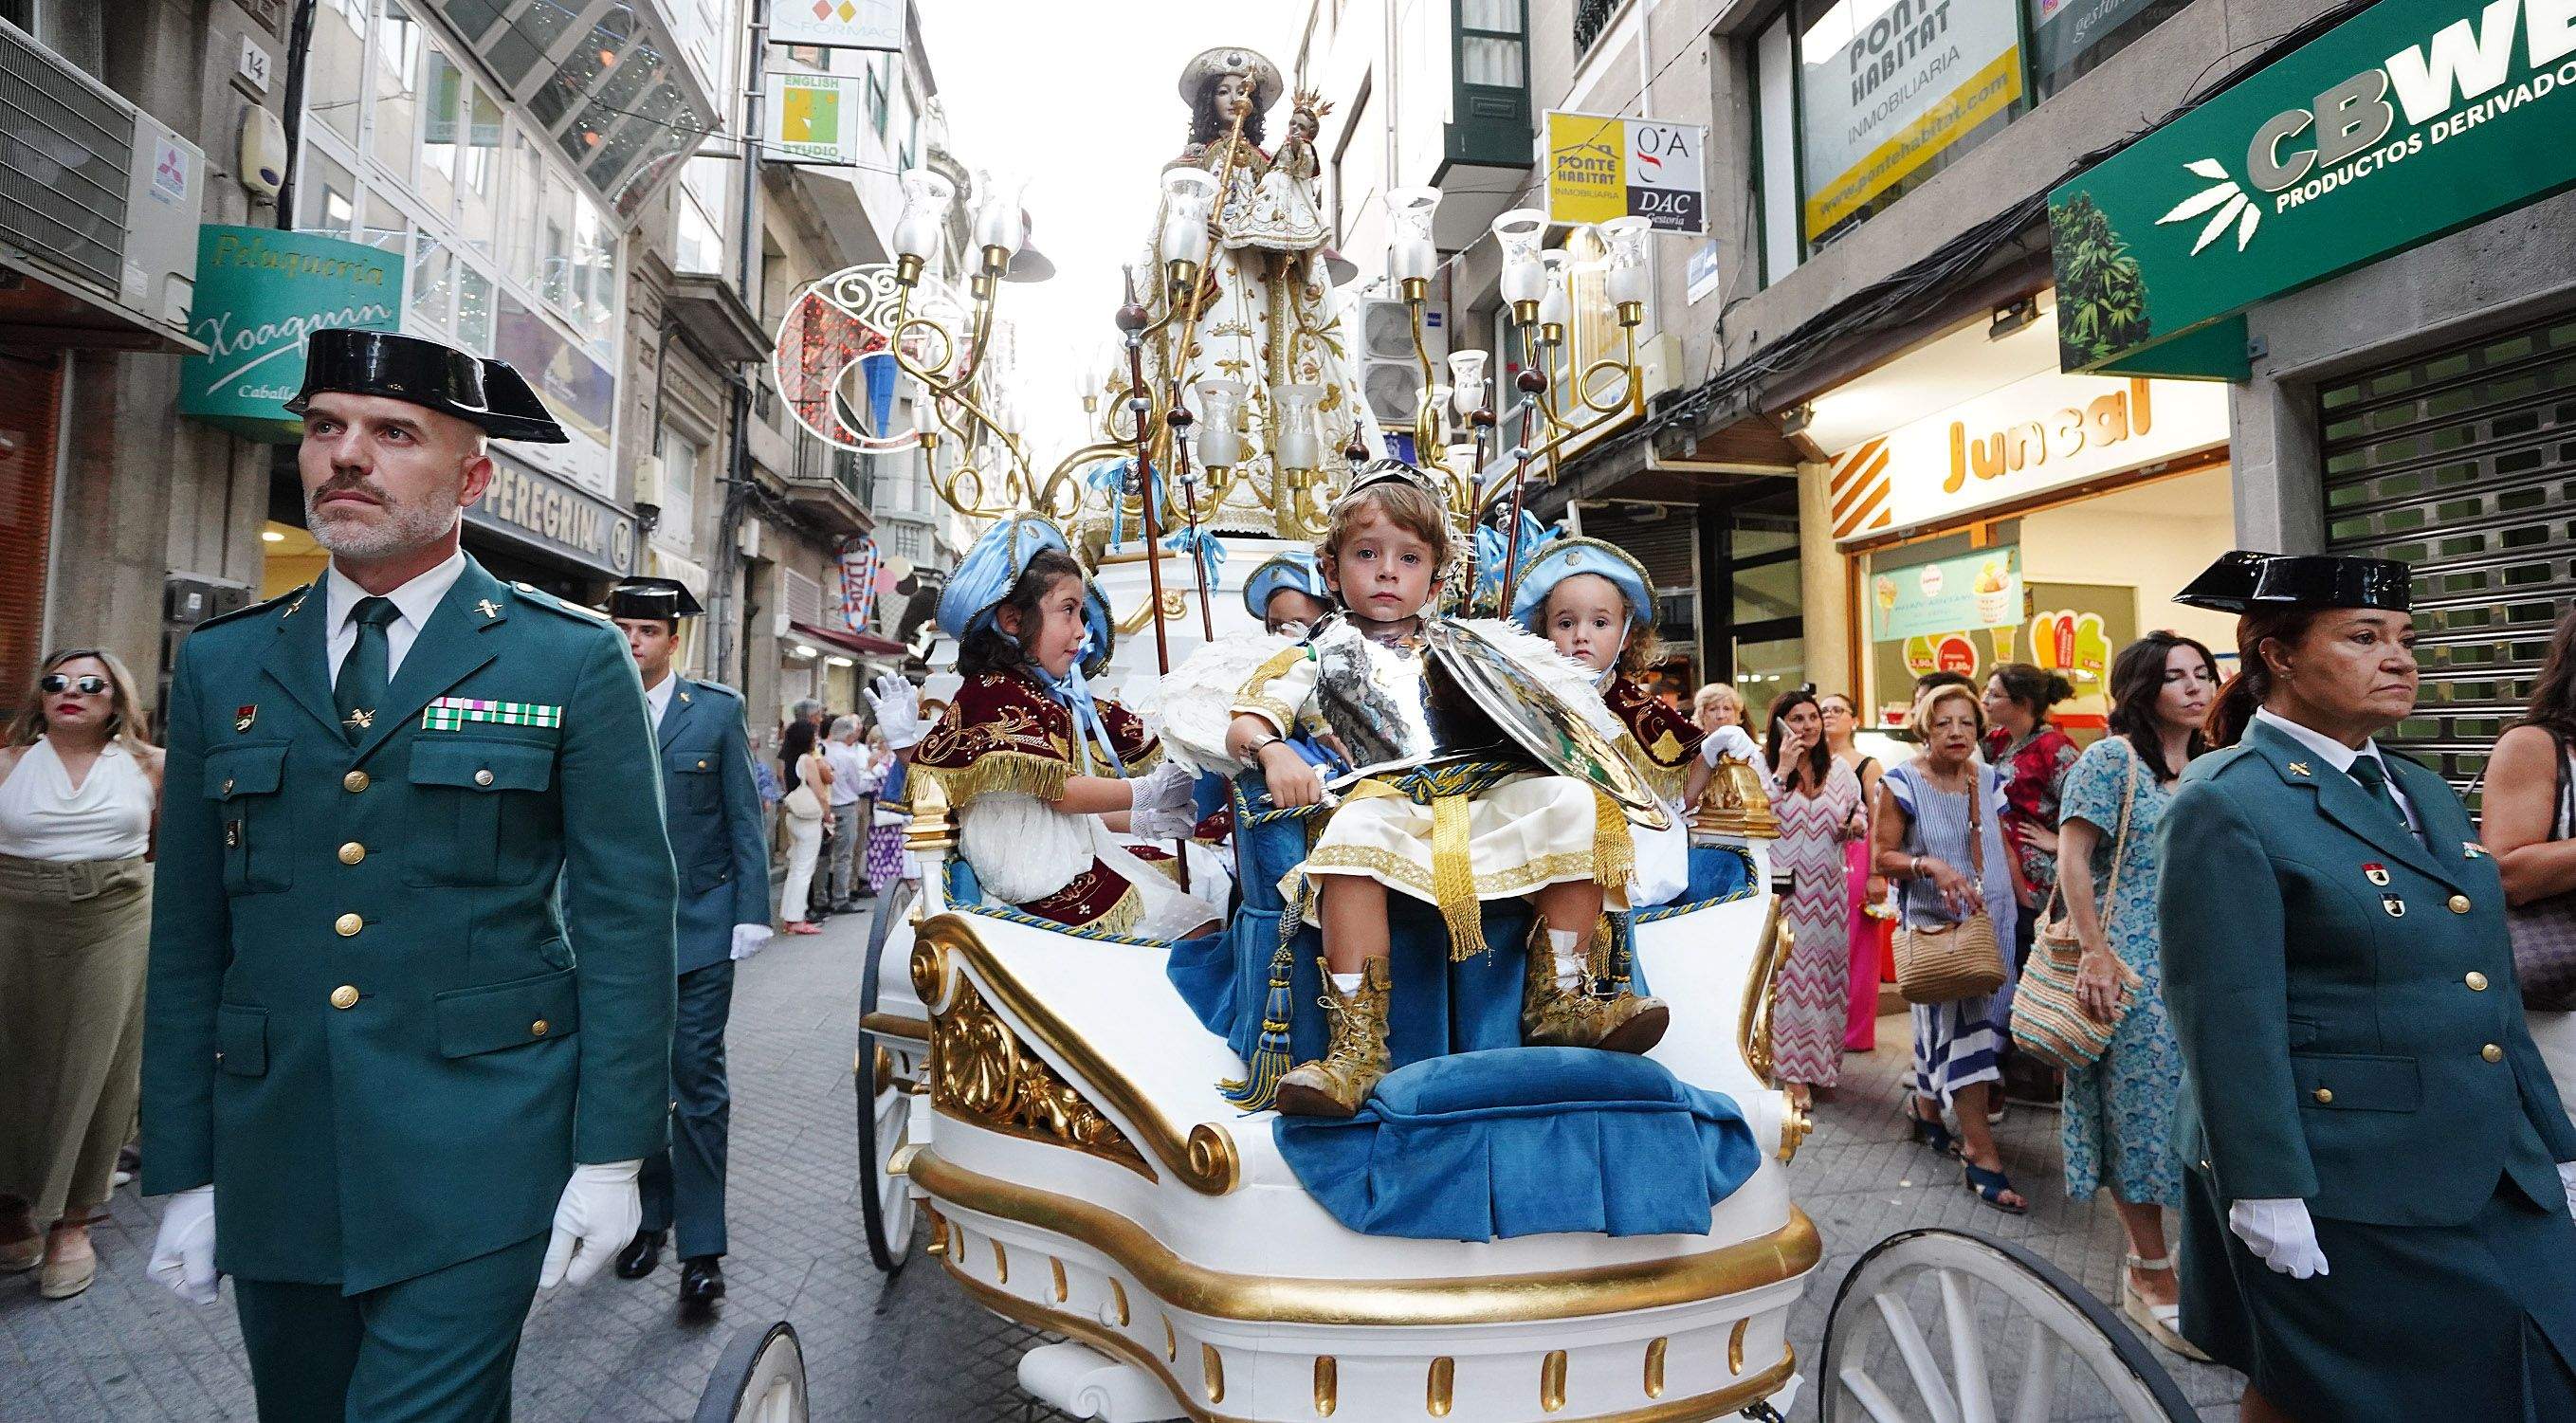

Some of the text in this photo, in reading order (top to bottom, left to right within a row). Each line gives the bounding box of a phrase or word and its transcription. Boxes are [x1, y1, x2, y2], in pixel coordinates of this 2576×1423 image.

[247, 50, 265, 81] 14
[1852, 0, 1950, 107] HABITAT
[784, 75, 839, 88] ENGLISH
[1849, 46, 1961, 145] INMOBILIARIA
[783, 144, 838, 157] STUDIO
[1820, 72, 2009, 216] www.pontehabitat.com
[1558, 155, 1616, 172] PONTE
[2276, 133, 2423, 214] PRODUCTOS
[1558, 172, 1617, 185] HABITAT
[1555, 187, 1619, 199] INMOBILIARIA
[1638, 192, 1691, 214] DAC
[1944, 378, 2151, 493] Juncal
